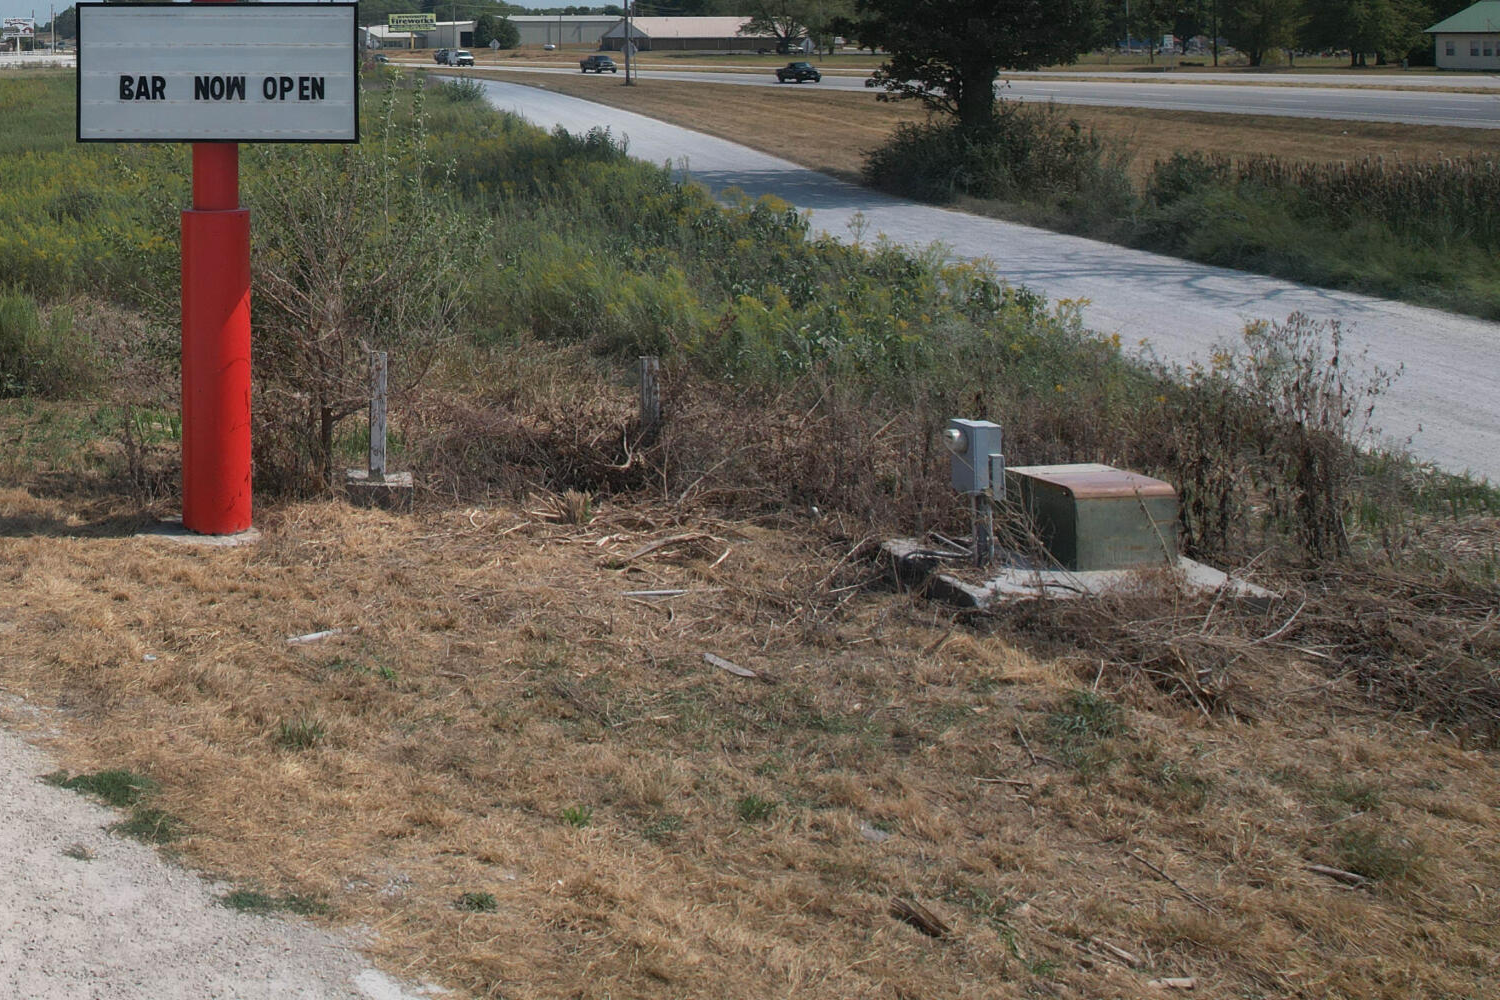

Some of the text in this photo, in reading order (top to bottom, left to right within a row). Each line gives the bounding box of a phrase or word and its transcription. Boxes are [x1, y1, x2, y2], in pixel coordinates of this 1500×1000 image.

[119, 74, 325, 101] BAR NOW OPEN
